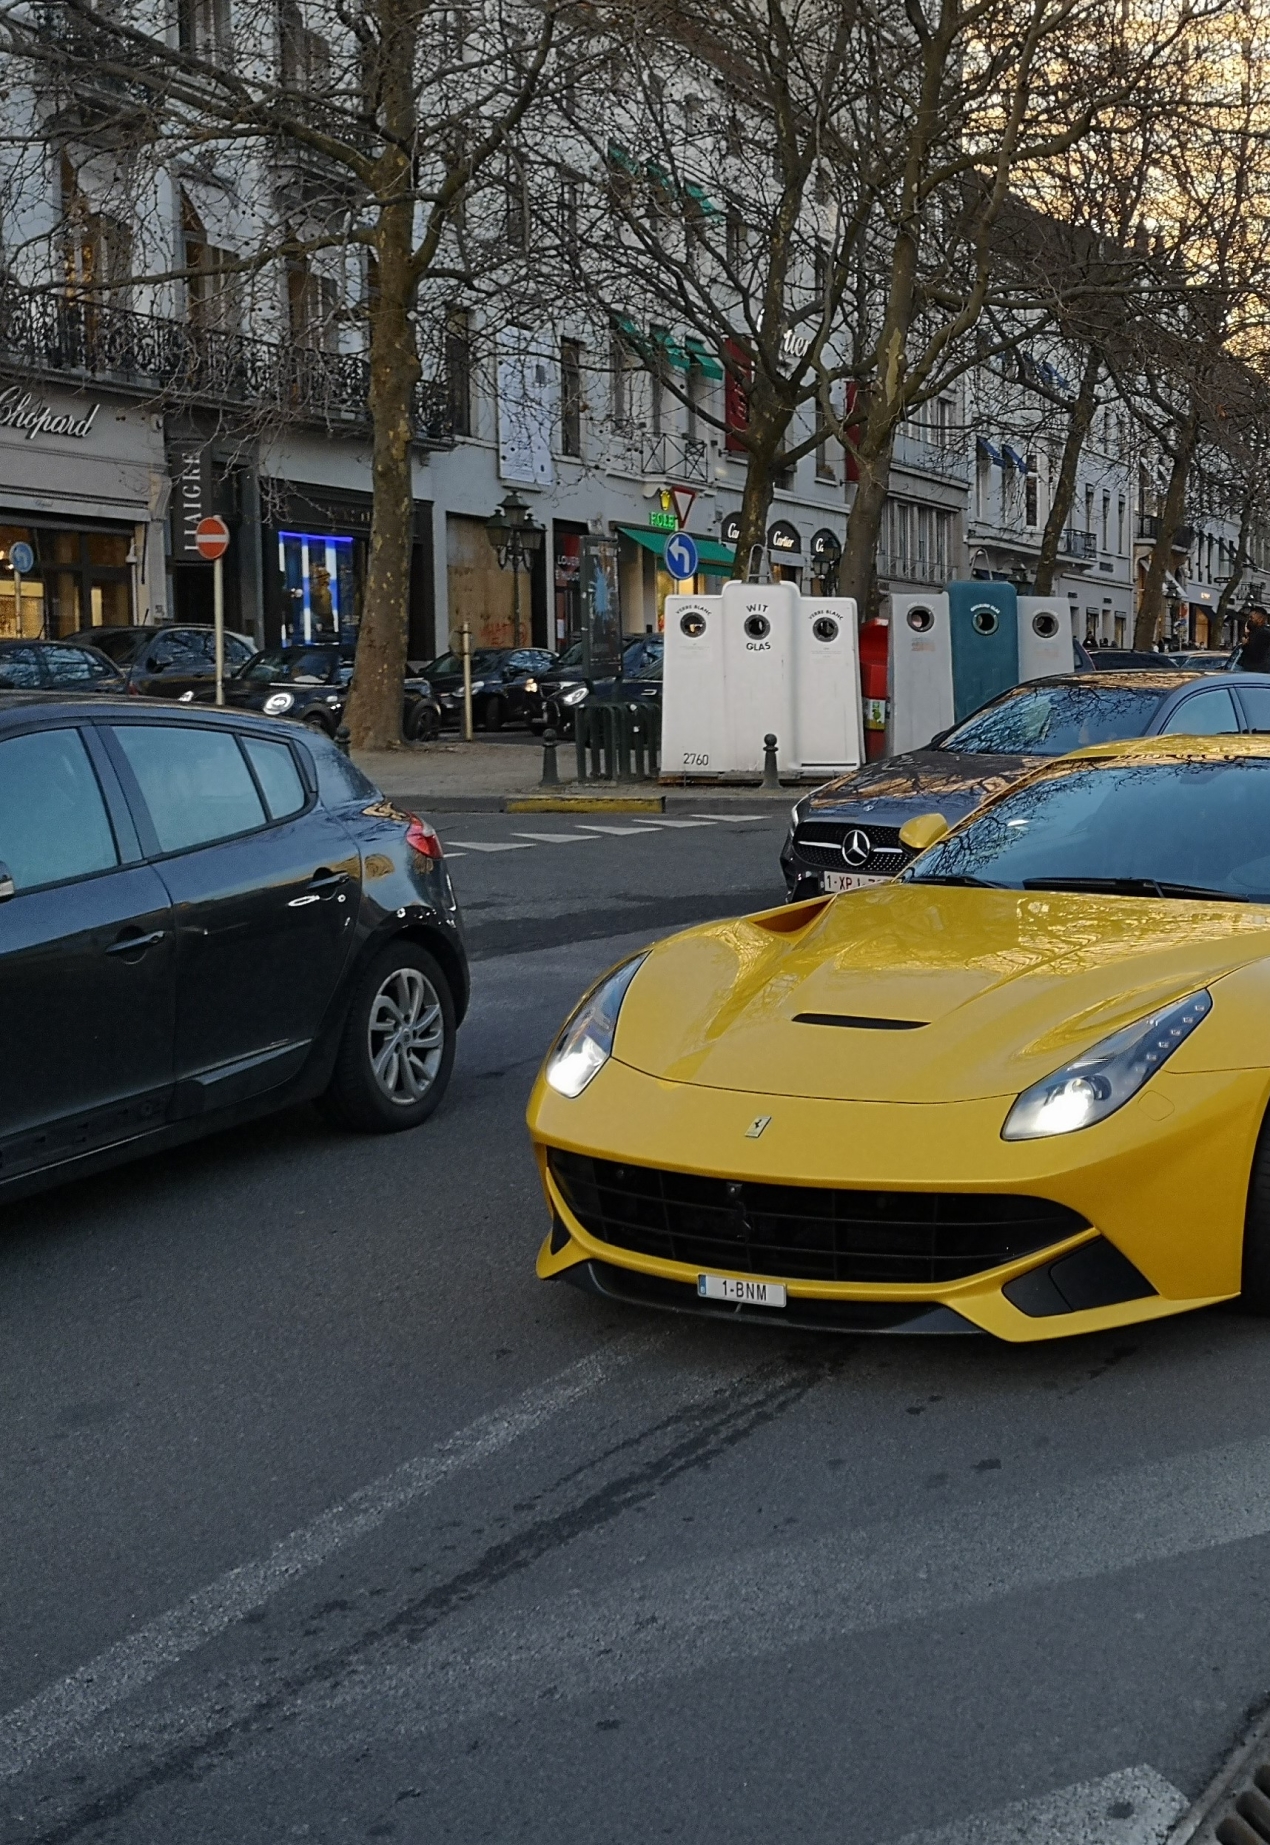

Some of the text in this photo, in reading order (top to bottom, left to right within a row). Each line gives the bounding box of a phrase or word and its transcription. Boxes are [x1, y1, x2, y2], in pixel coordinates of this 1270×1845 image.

[0, 385, 100, 439] Chopard
[650, 512, 676, 529] ROLE
[773, 531, 794, 547] Cartier
[746, 604, 769, 613] WIT
[746, 642, 771, 651] GLAS
[683, 753, 709, 766] 2760
[722, 1280, 767, 1301] 1-BNM
